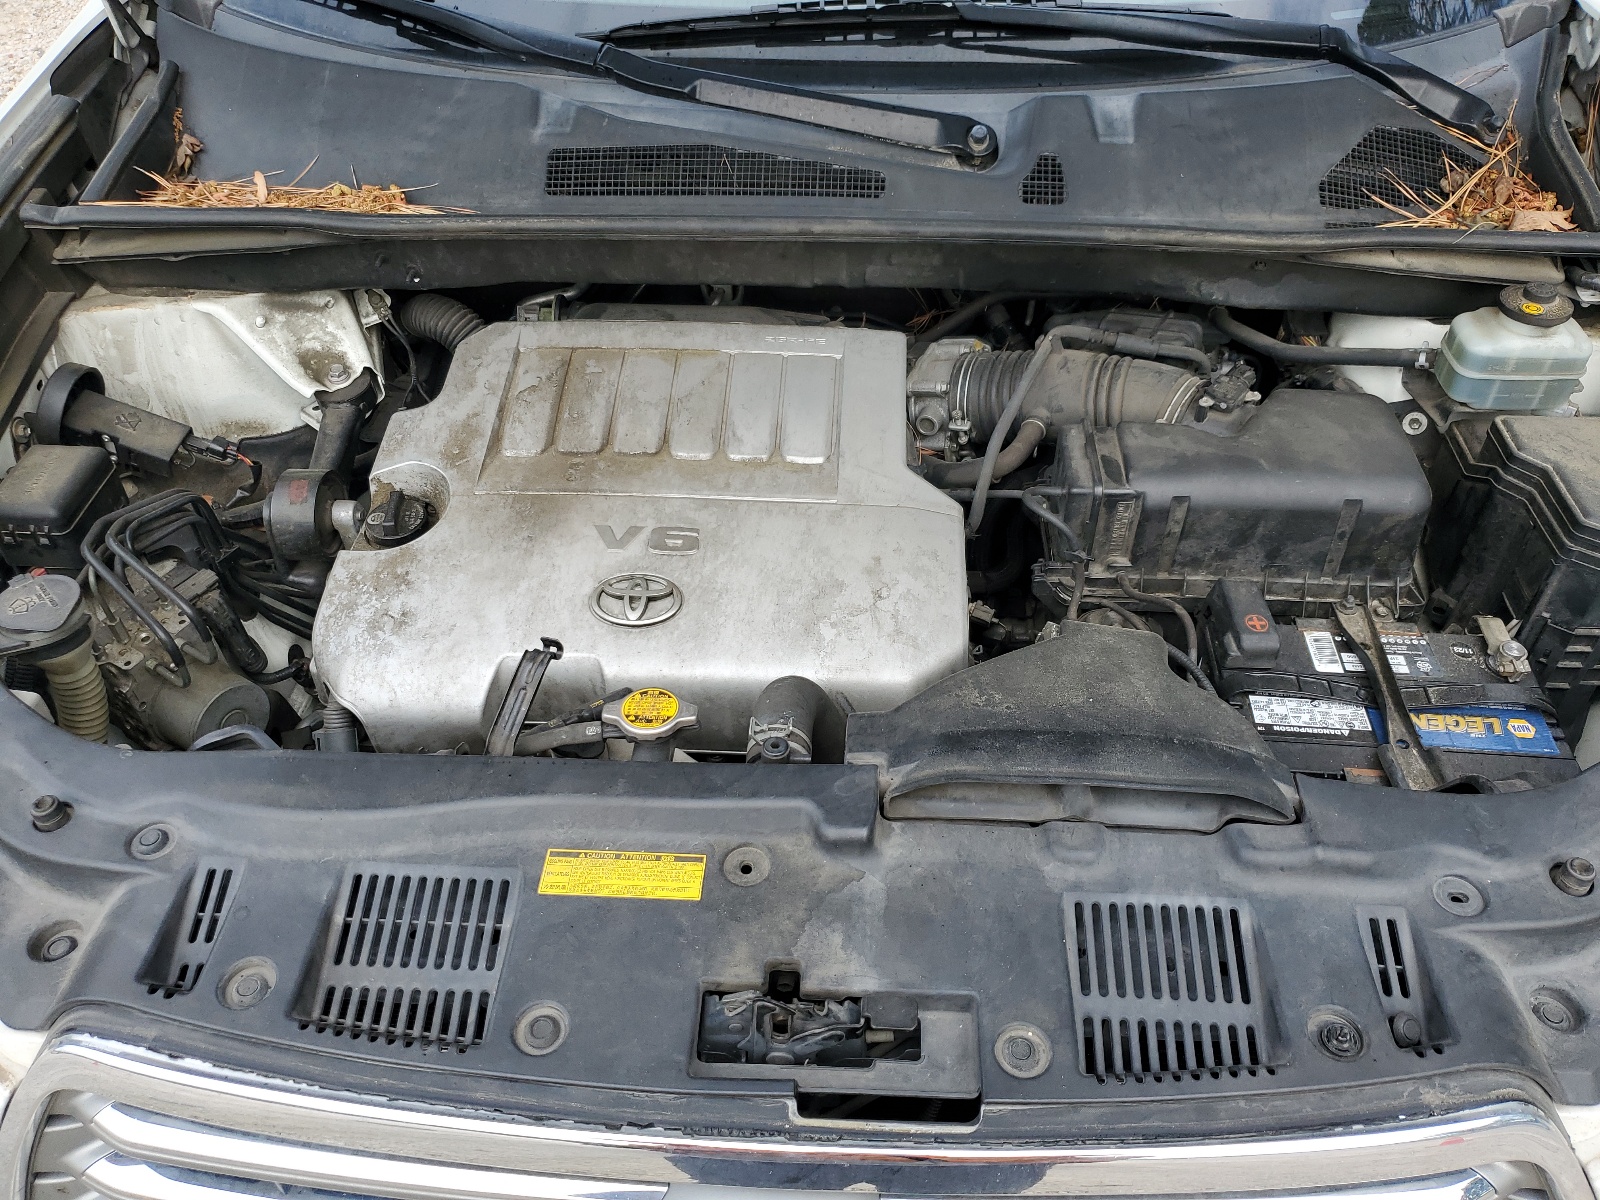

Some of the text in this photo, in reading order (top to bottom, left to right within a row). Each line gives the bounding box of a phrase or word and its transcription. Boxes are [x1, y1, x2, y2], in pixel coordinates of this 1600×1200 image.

[594, 524, 700, 555] V6
[1453, 646, 1474, 655] 11/23
[1510, 723, 1532, 733] NAPA
[587, 852, 616, 860] CAUTION
[620, 853, 657, 862] ATTENTION
